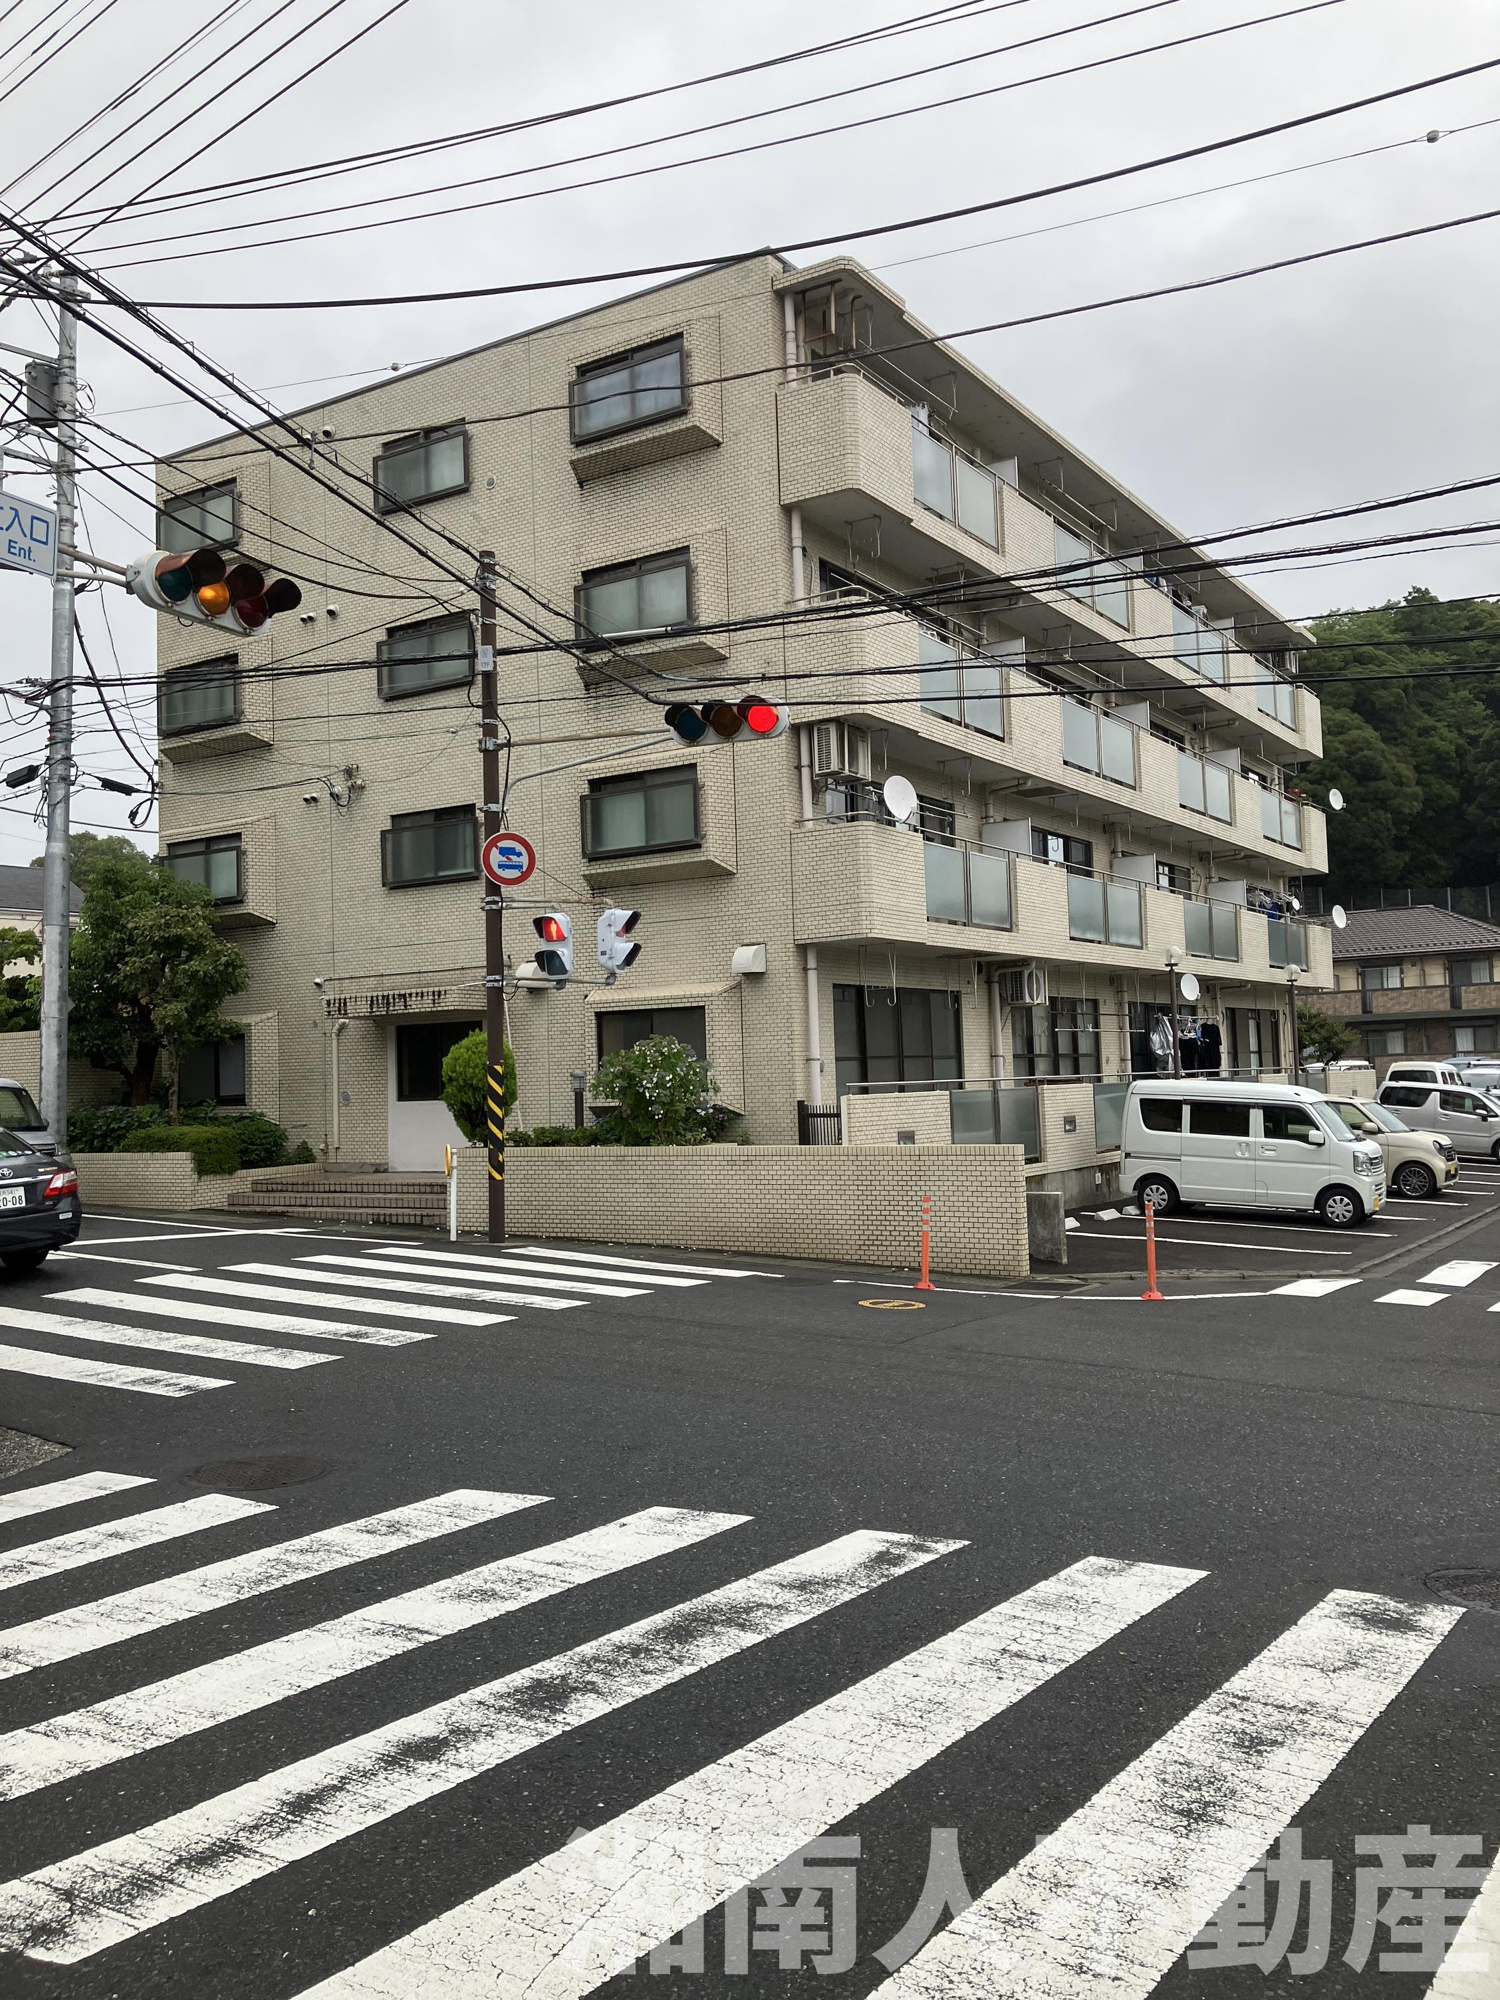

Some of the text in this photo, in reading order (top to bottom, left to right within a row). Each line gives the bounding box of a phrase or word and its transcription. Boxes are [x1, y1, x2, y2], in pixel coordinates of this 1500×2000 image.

[0, 506, 49, 546] 入口
[7, 538, 36, 563] Ent.
[0, 1195, 23, 1208] 0-08
